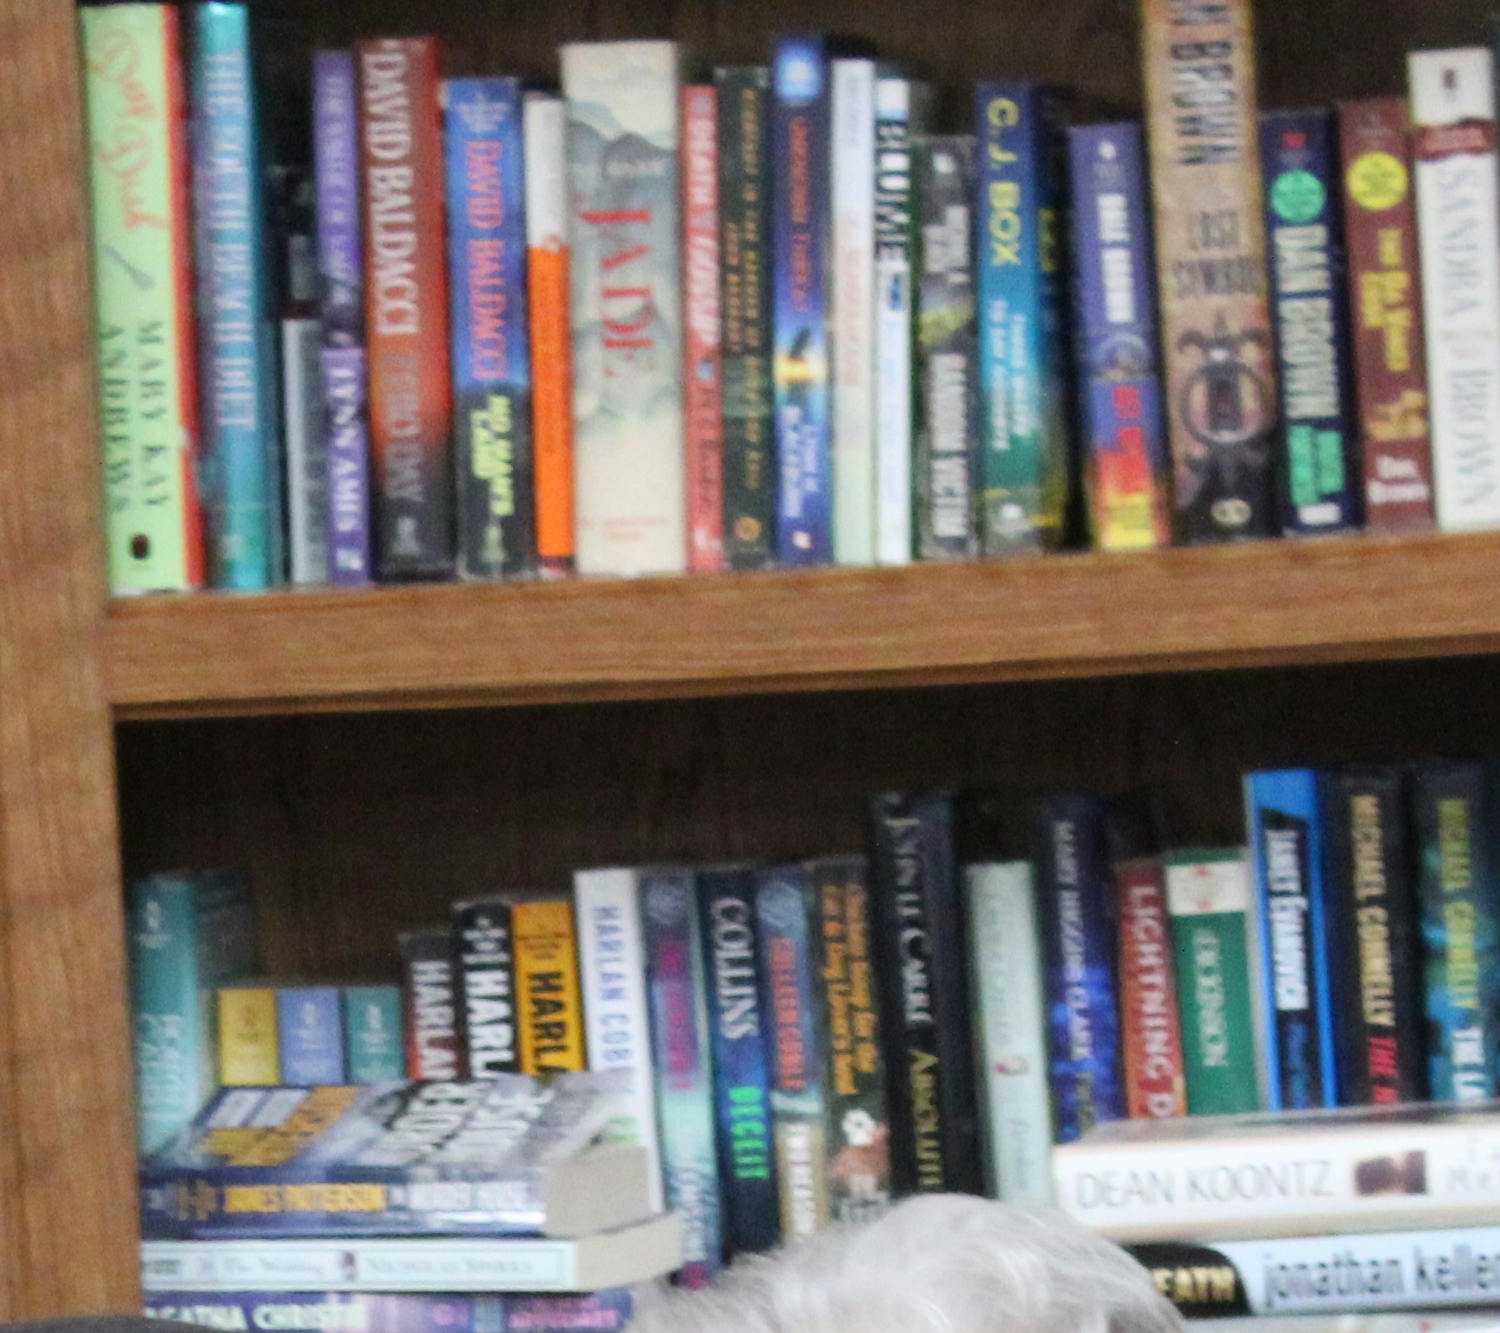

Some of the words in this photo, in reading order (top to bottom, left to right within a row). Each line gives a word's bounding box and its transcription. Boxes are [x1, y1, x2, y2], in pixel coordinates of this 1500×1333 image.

[206, 52, 245, 117] THE
[361, 52, 411, 158] DAVID
[987, 97, 1022, 137] C.
[1170, 39, 1244, 165] BROWN
[464, 139, 503, 229] DAVID
[874, 118, 910, 262] BLUME
[989, 143, 1019, 170] J.
[369, 165, 420, 336] BALDACCI
[990, 180, 1021, 267] BOX
[1274, 225, 1329, 292] DAN
[1437, 167, 1482, 317] SANDRA
[468, 239, 507, 380] BALDACCI
[577, 206, 655, 378] JADE
[136, 320, 169, 421] MARY
[214, 358, 256, 433] DIET
[1278, 297, 1340, 418] BROWN
[98, 323, 134, 514] ANDREWS
[329, 368, 361, 447] LYNN
[929, 353, 968, 452] RANDOM
[1448, 368, 1497, 506] BROWN
[142, 443, 171, 508] KAY
[333, 456, 363, 533] AMES
[385, 441, 425, 503] DAY
[930, 455, 968, 538] VICTIM
[1053, 820, 1078, 885] MARY
[1264, 830, 1302, 893] JANET
[1350, 795, 1387, 900] MICHAEL
[1438, 798, 1473, 892] MICHAEL
[591, 906, 630, 1002] HARLAN
[711, 897, 764, 1040] COLLINS
[1059, 888, 1086, 983] HIGGINS
[1355, 904, 1396, 1027] CONNELLY
[1443, 900, 1480, 1009] CONNELLY
[411, 961, 458, 1080] HARLA
[768, 937, 803, 1024] COLLEEN
[849, 962, 873, 1008] Soup
[1064, 985, 1092, 1061] CLARK
[1129, 886, 1171, 1080] LIGHTNING
[598, 1012, 634, 1073] COB
[776, 1029, 807, 1090] COBLE
[854, 1012, 877, 1038] for
[856, 1043, 878, 1074] the
[1367, 1036, 1397, 1077] THE
[1451, 1026, 1485, 1065] THE
[834, 1055, 857, 1095] Soul
[727, 1086, 770, 1181] DECEIT
[1075, 1167, 1177, 1210] DEAN
[1185, 1159, 1338, 1204] KOONTZ
[253, 1303, 369, 1332] CHRISTIE
[1152, 1264, 1234, 1303] EATH
[1262, 1252, 1404, 1308] jonathan
